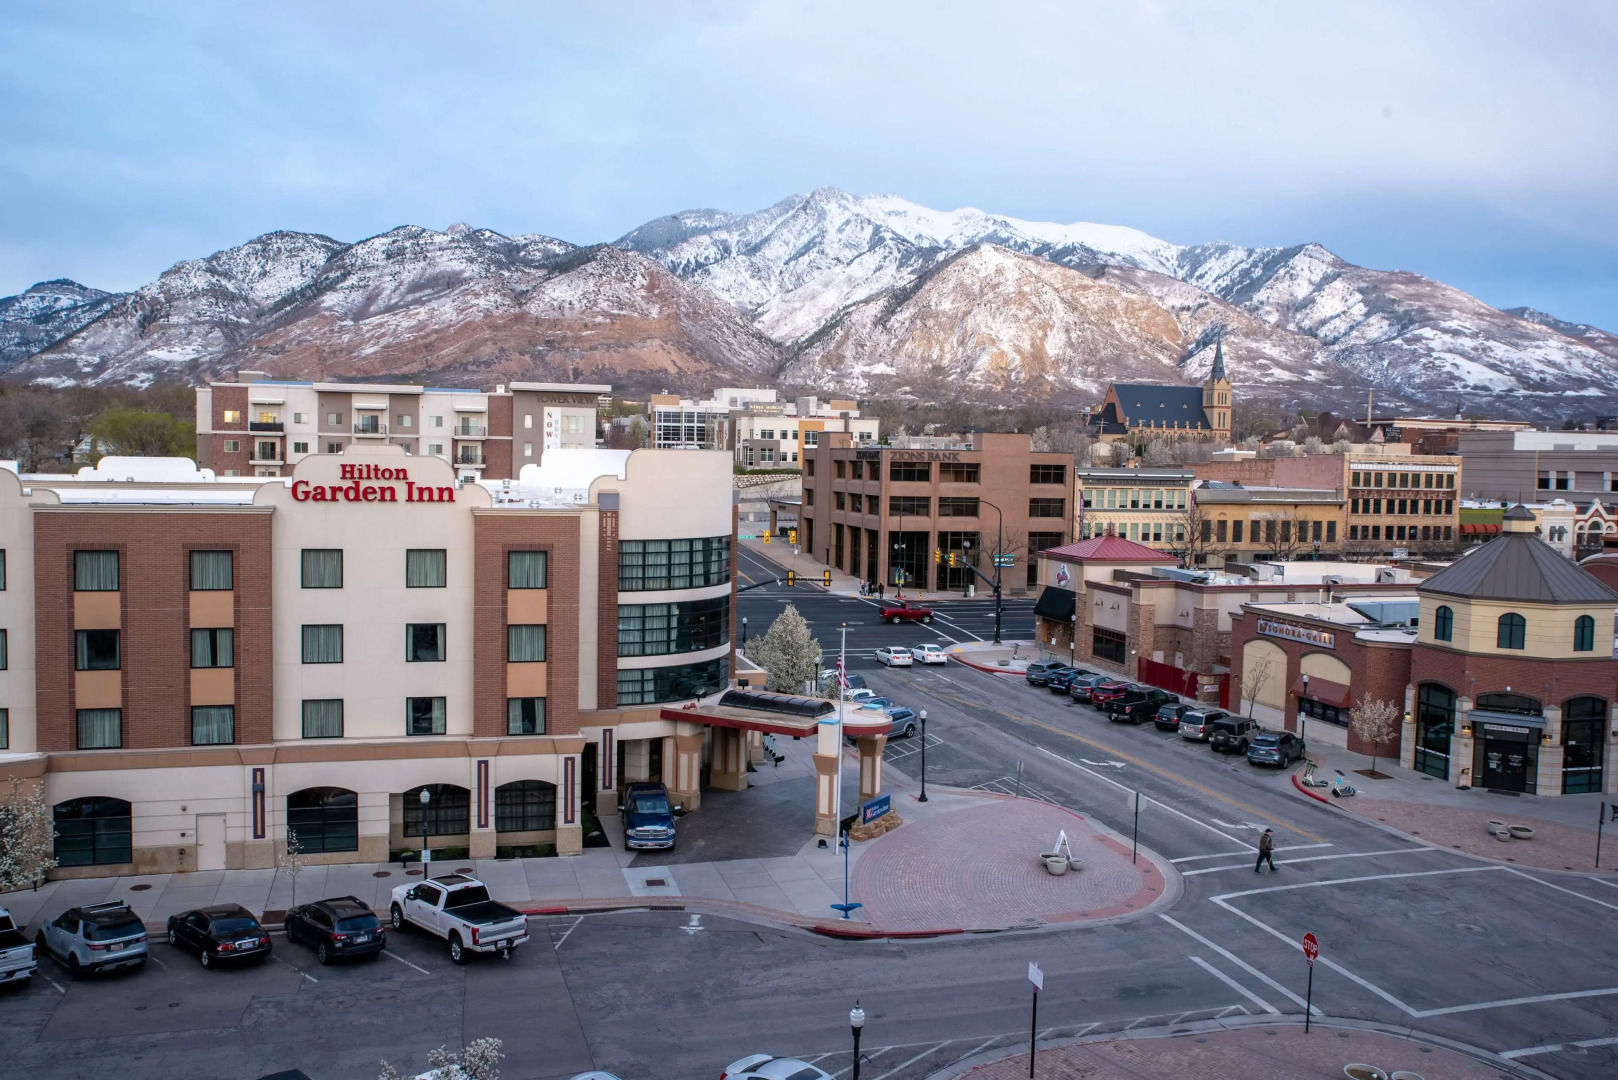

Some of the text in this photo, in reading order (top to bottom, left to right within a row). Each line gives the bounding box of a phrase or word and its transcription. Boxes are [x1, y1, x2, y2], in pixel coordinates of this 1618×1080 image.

[536, 395, 595, 404] TOWER VIEW
[890, 451, 960, 461] ZIONS BANK
[340, 463, 408, 480] Hilton
[291, 480, 455, 502] Garden Inn
[1268, 624, 1333, 645] SONORA GRILL
[1304, 939, 1317, 953] STOP
